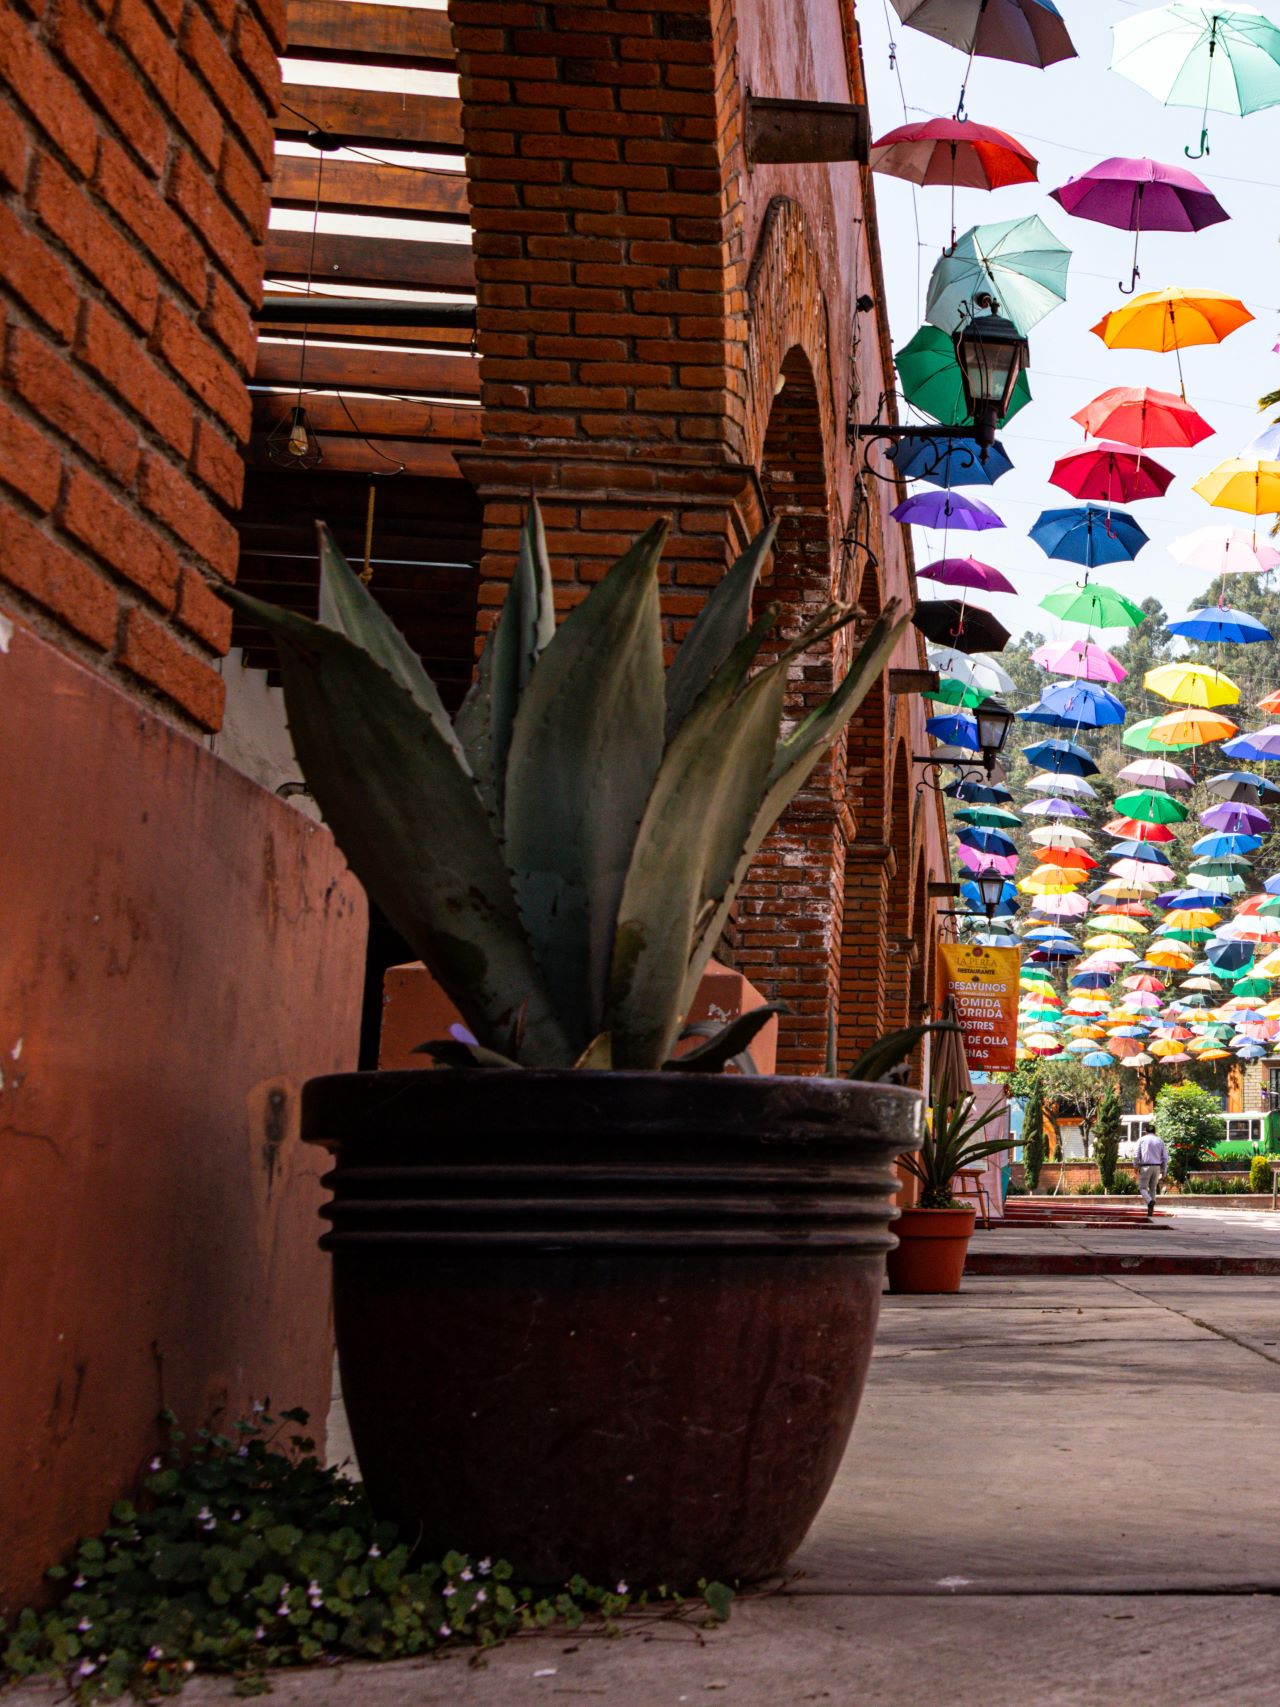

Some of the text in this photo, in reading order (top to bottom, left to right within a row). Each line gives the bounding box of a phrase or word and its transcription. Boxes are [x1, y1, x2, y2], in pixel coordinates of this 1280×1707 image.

[957, 957, 966, 966] LA
[949, 981, 1007, 992] DESAYUNOS
[957, 1008, 1003, 1018] ORRIDA
[960, 1020, 994, 1030] OSTRES
[968, 1035, 980, 1044] DE
[983, 1036, 1008, 1045] OLLA
[966, 1049, 989, 1058] ENAS
